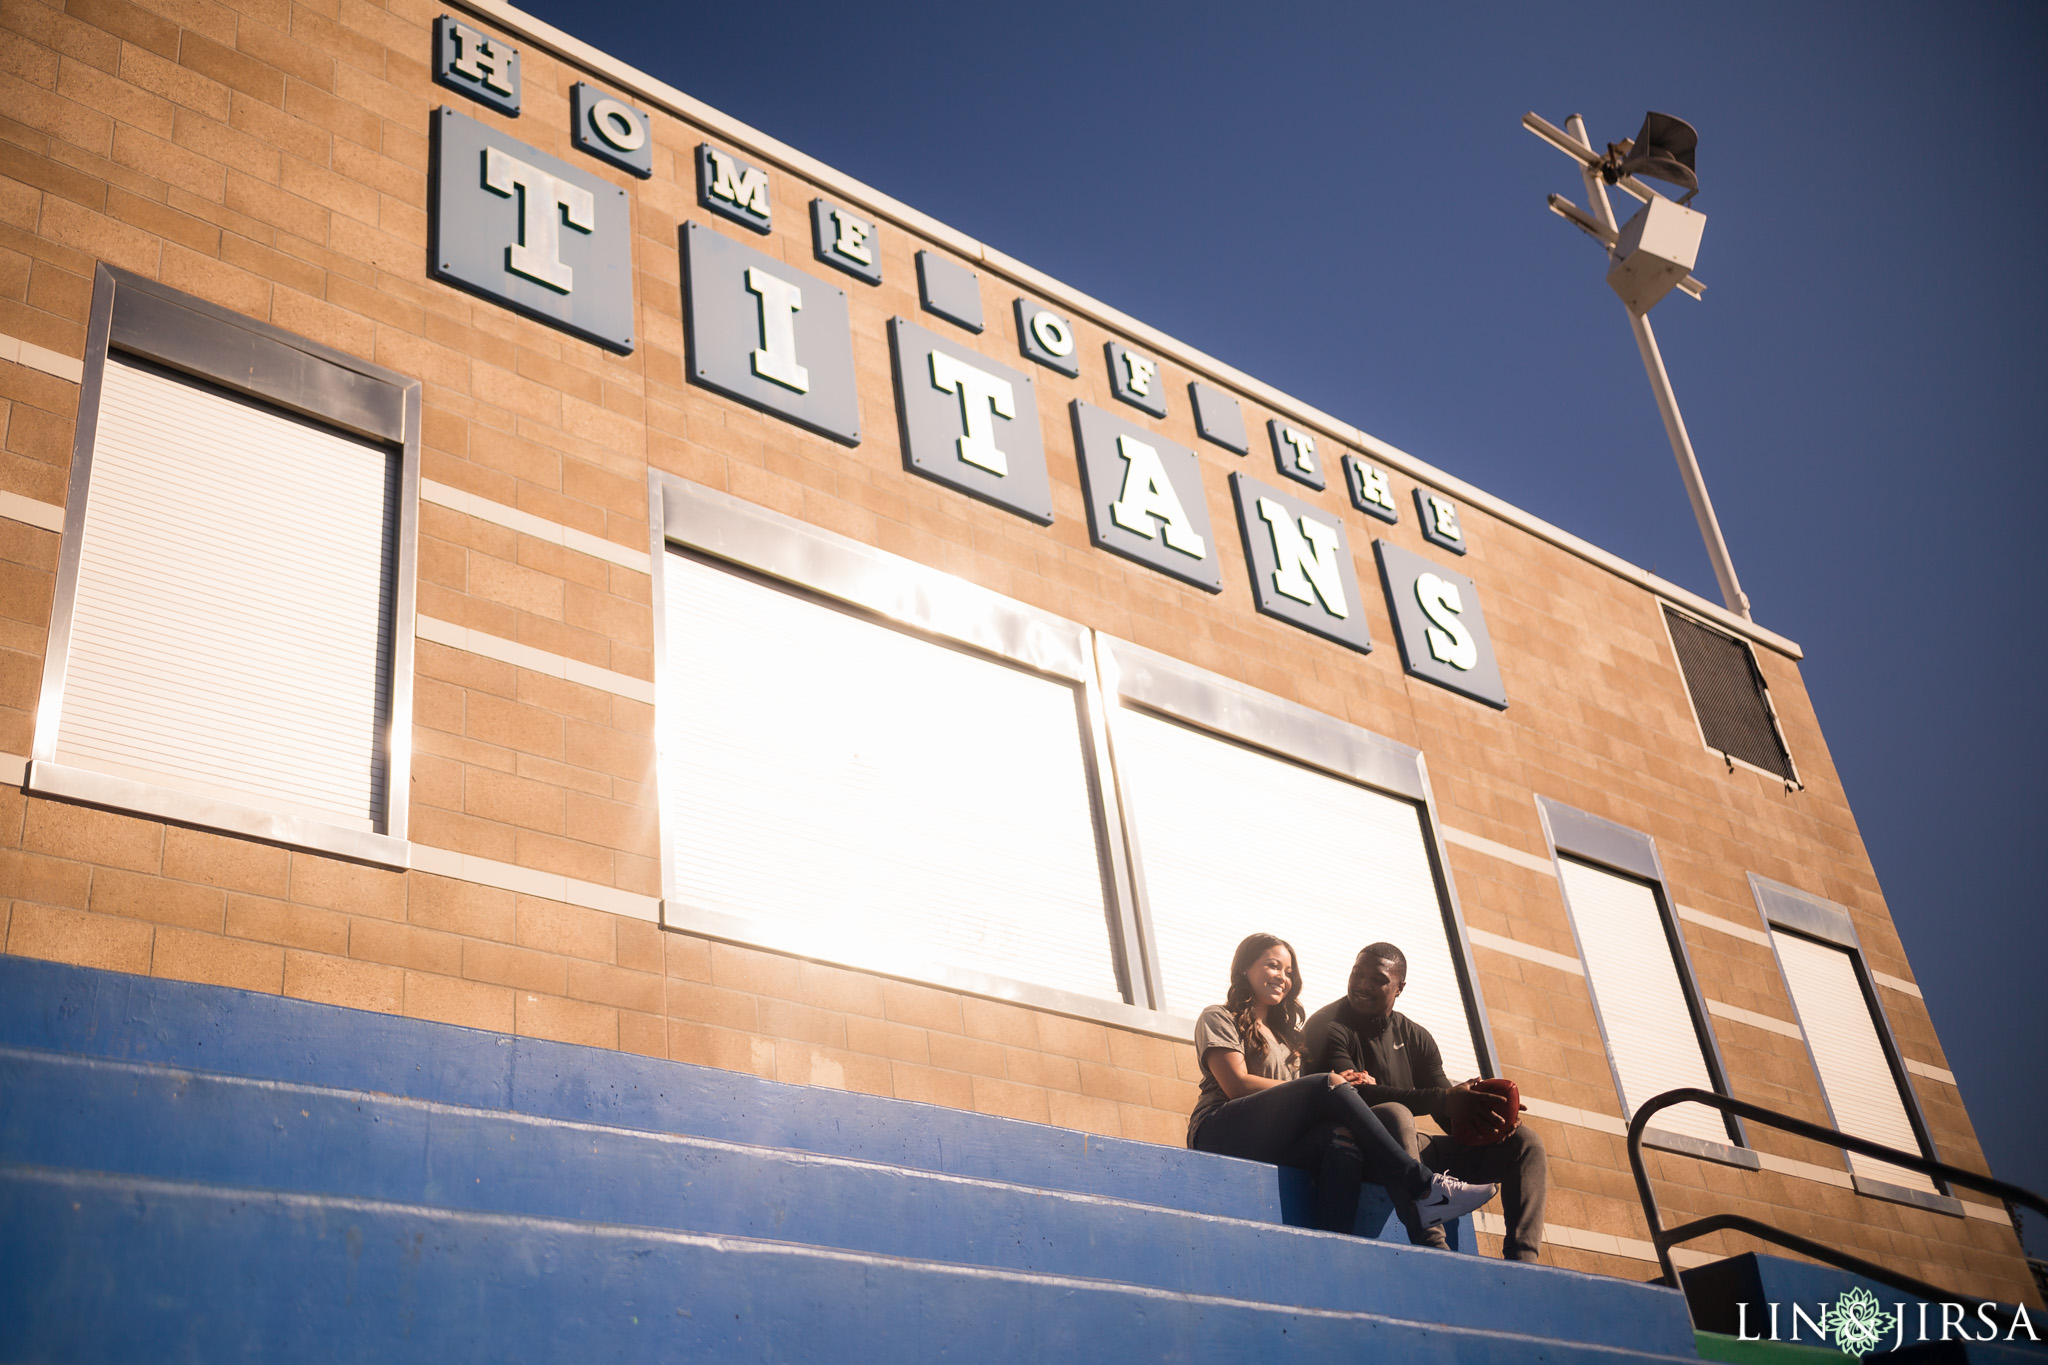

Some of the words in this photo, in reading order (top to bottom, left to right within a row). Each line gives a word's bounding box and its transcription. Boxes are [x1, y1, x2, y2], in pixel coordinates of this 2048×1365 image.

[454, 23, 872, 265] HOME
[1032, 310, 1155, 396] OF
[1284, 426, 1460, 542] THE
[483, 145, 1478, 671] TITANS
